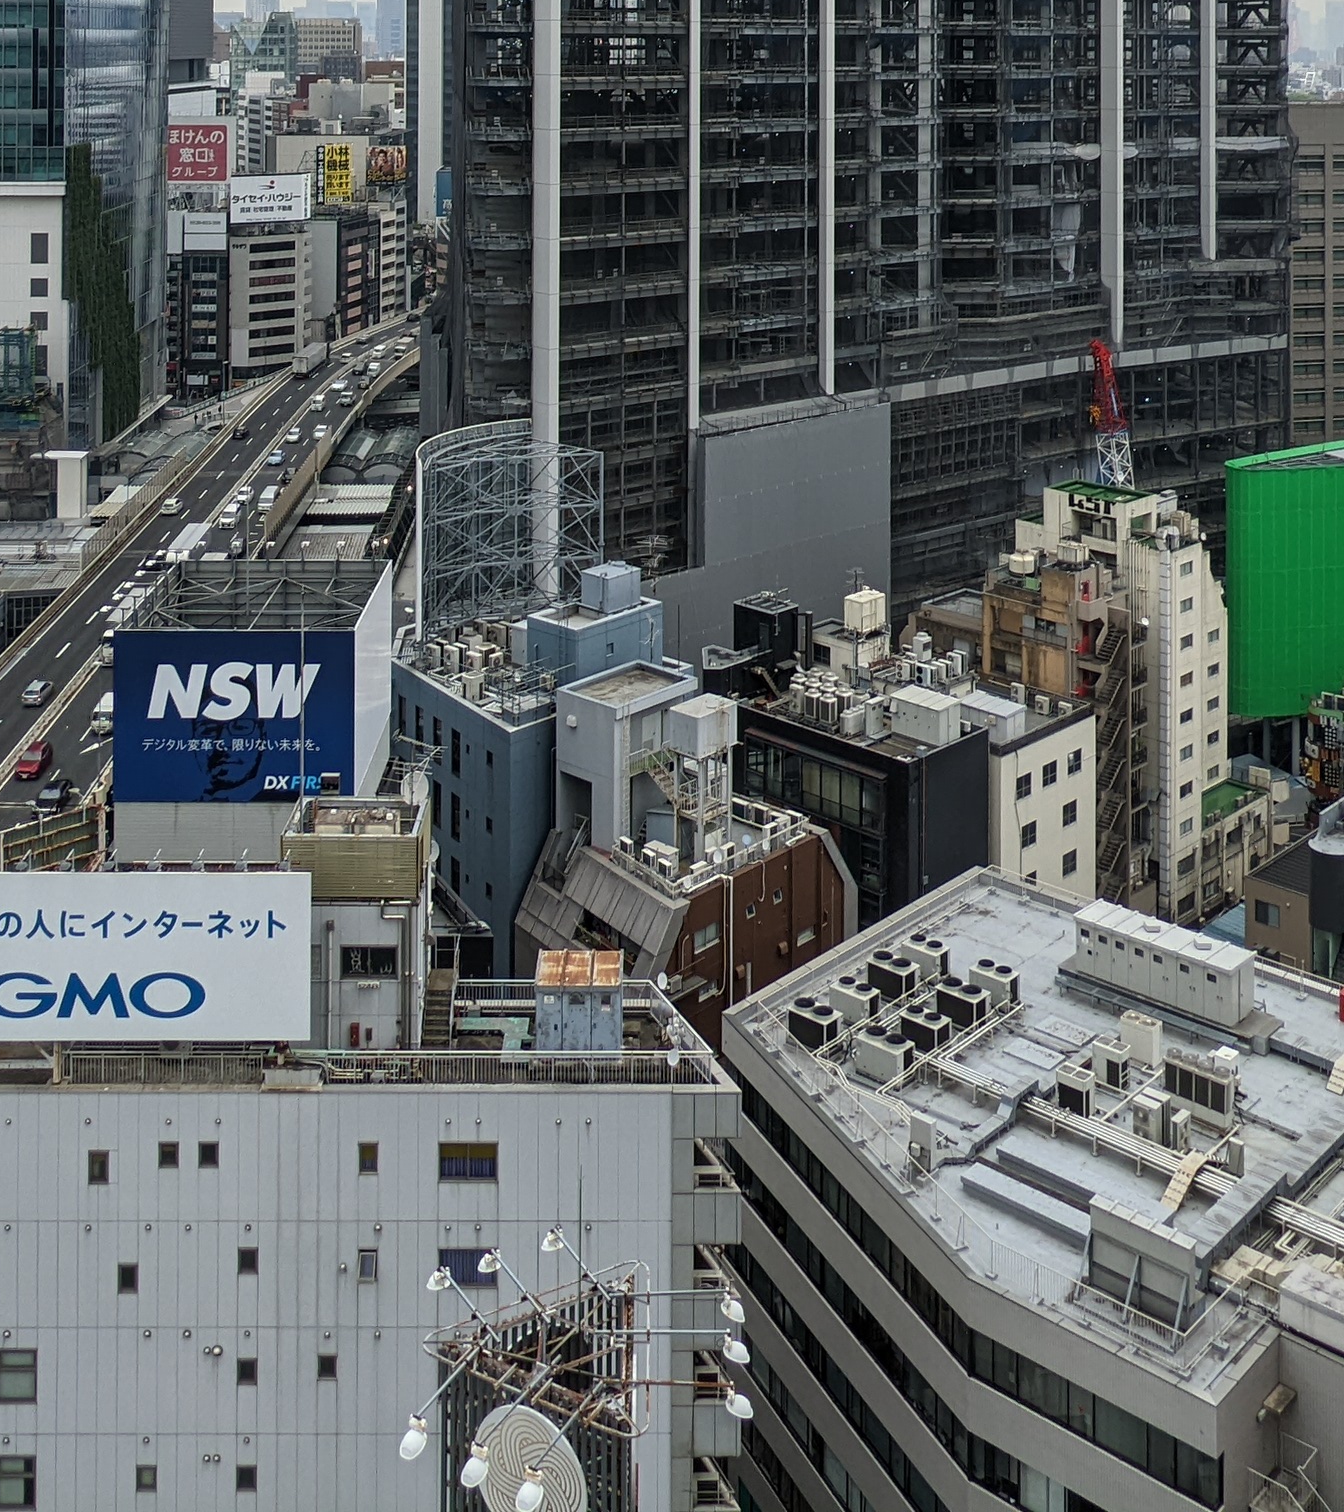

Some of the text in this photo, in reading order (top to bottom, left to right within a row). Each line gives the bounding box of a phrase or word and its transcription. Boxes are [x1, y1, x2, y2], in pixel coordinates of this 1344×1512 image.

[172, 167, 218, 178] グループ
[231, 192, 301, 204] タイセイ・ハウジー
[146, 661, 321, 721] NSW
[142, 738, 321, 751] デジタル変革で、限りない未来を。
[264, 775, 290, 790] DX
